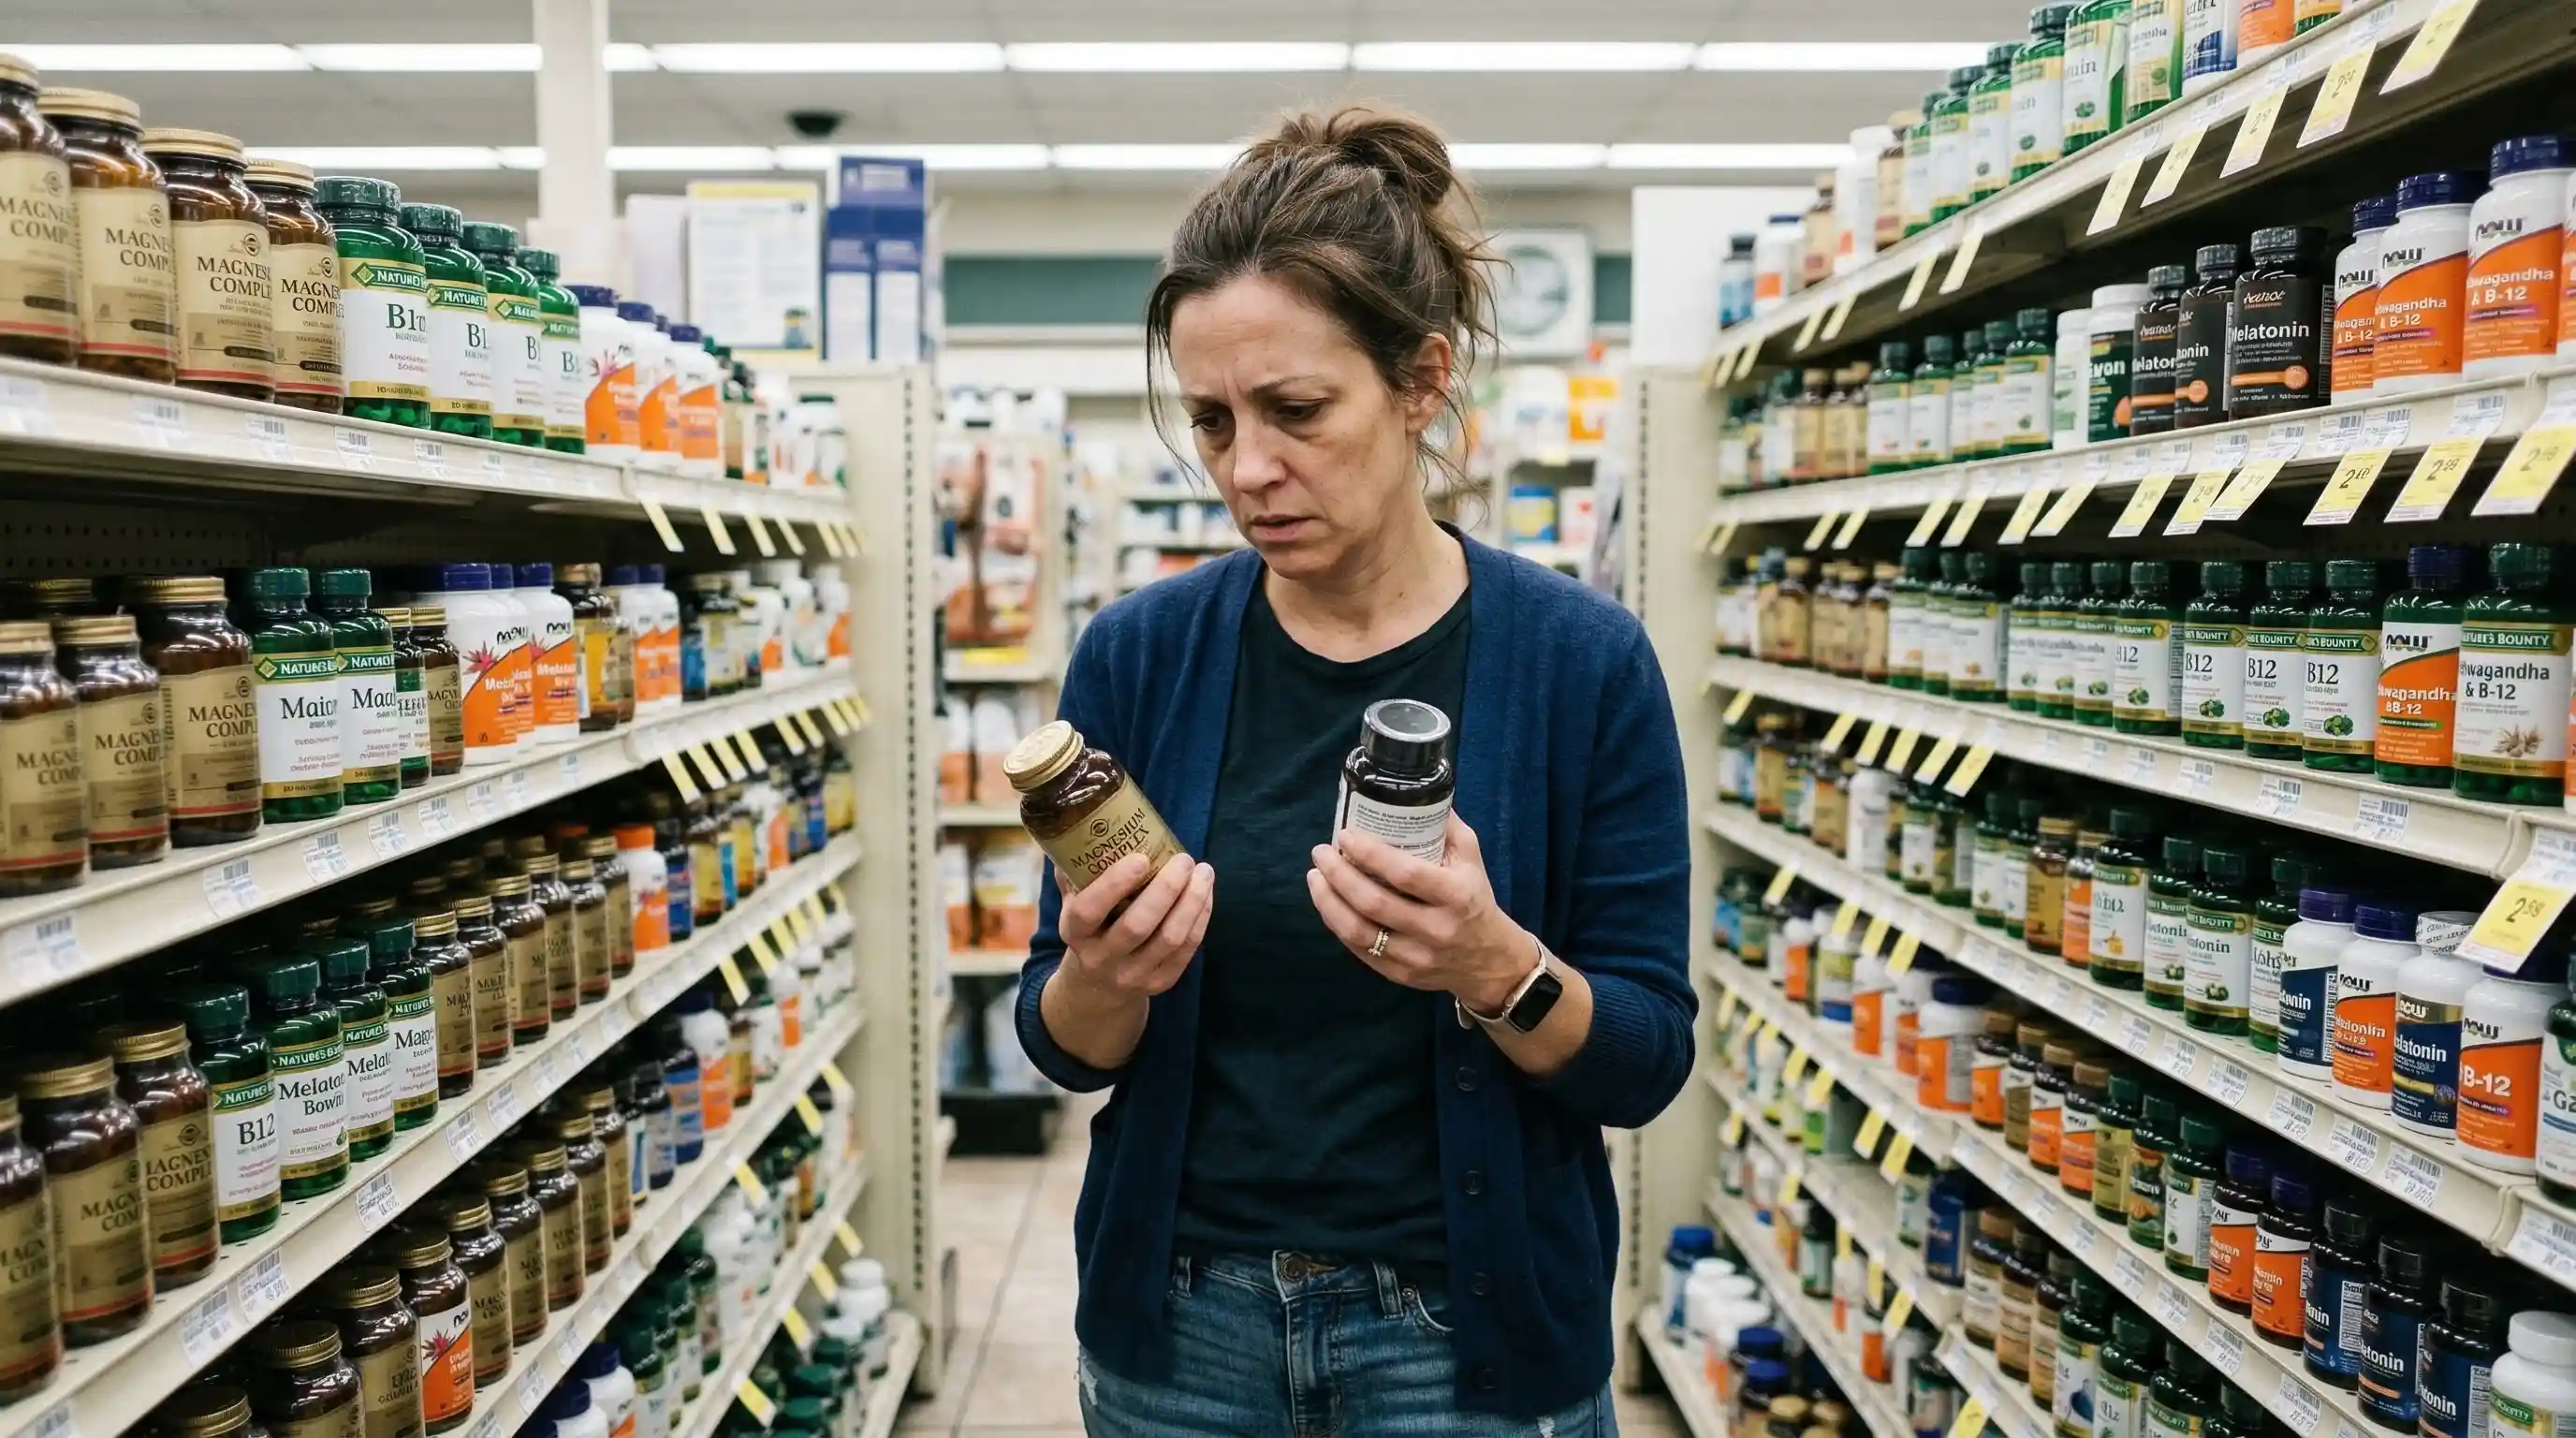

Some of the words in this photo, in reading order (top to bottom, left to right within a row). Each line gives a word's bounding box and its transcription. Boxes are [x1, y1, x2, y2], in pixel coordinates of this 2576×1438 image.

[2497, 633, 2550, 646] BOUNTY
[2247, 657, 2277, 680] B12
[2306, 662, 2339, 685] B12
[2466, 682, 2475, 697] &
[2479, 682, 2516, 700] B-12
[2465, 1068, 2511, 1098] B-12
